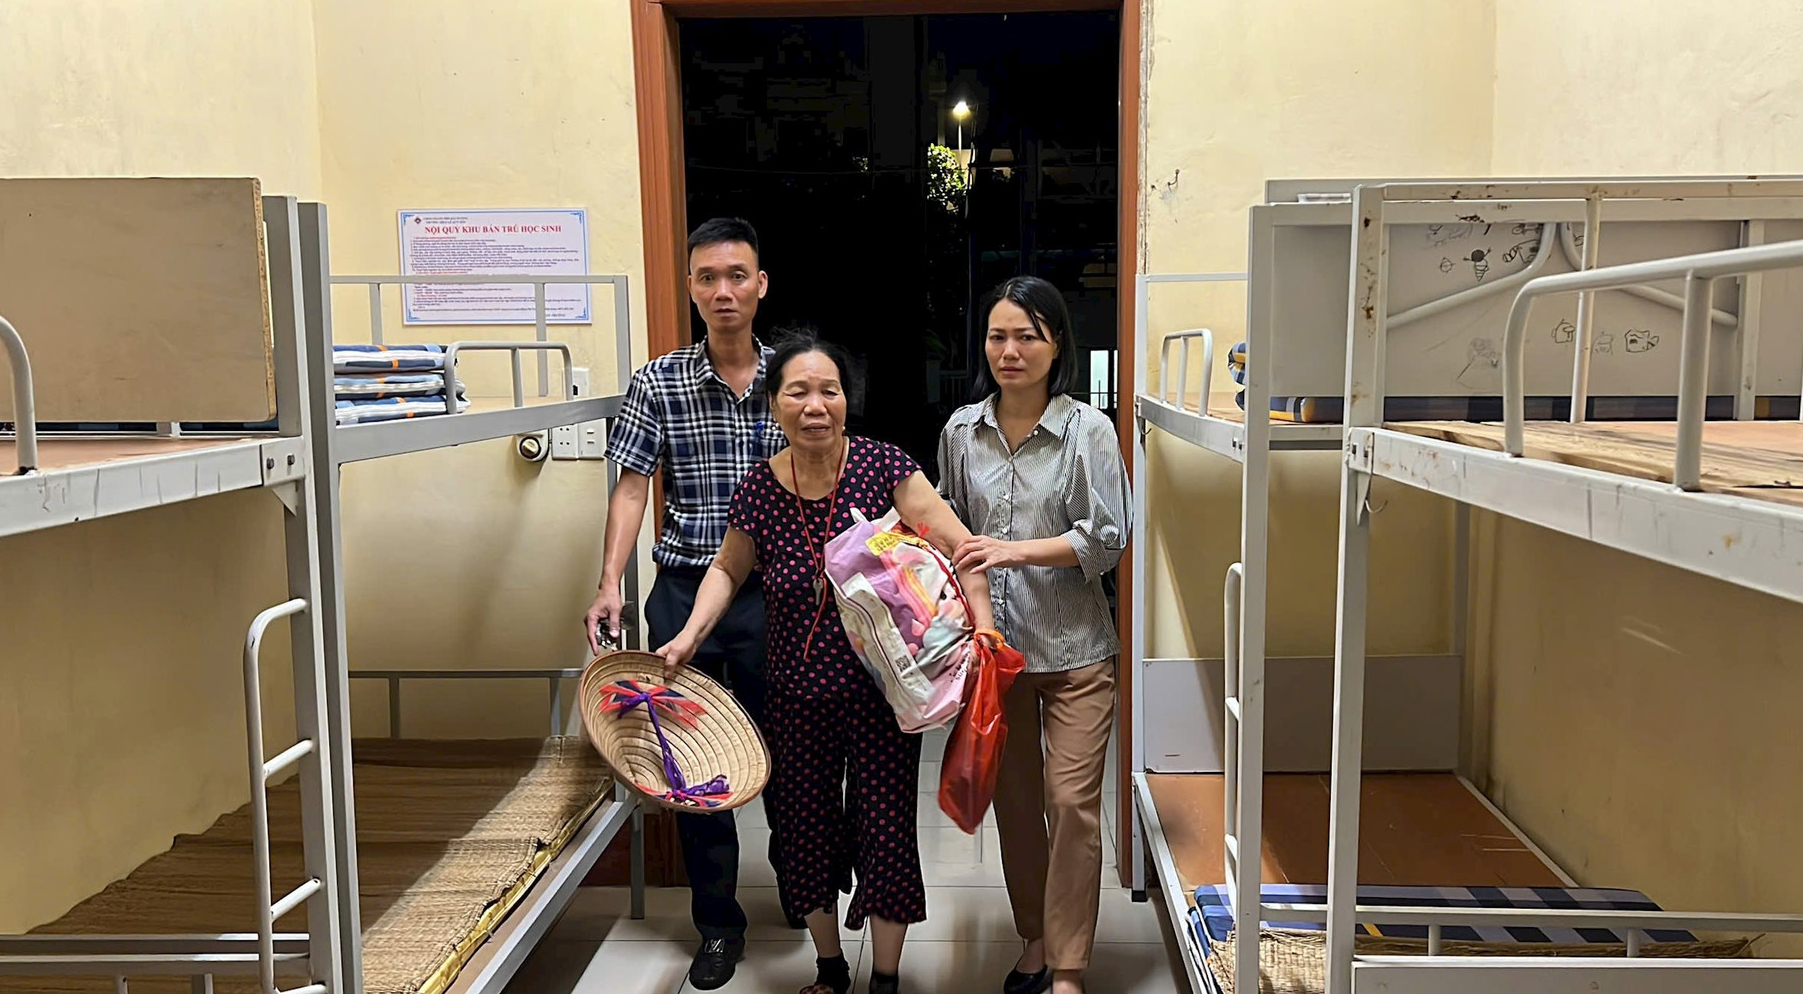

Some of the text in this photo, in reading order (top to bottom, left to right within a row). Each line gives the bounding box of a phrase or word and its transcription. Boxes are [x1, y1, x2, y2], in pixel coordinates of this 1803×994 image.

[462, 225, 480, 233] KHU
[502, 223, 519, 233] TRÚ
[522, 225, 539, 234] HỌC
[541, 225, 562, 233] SINH
